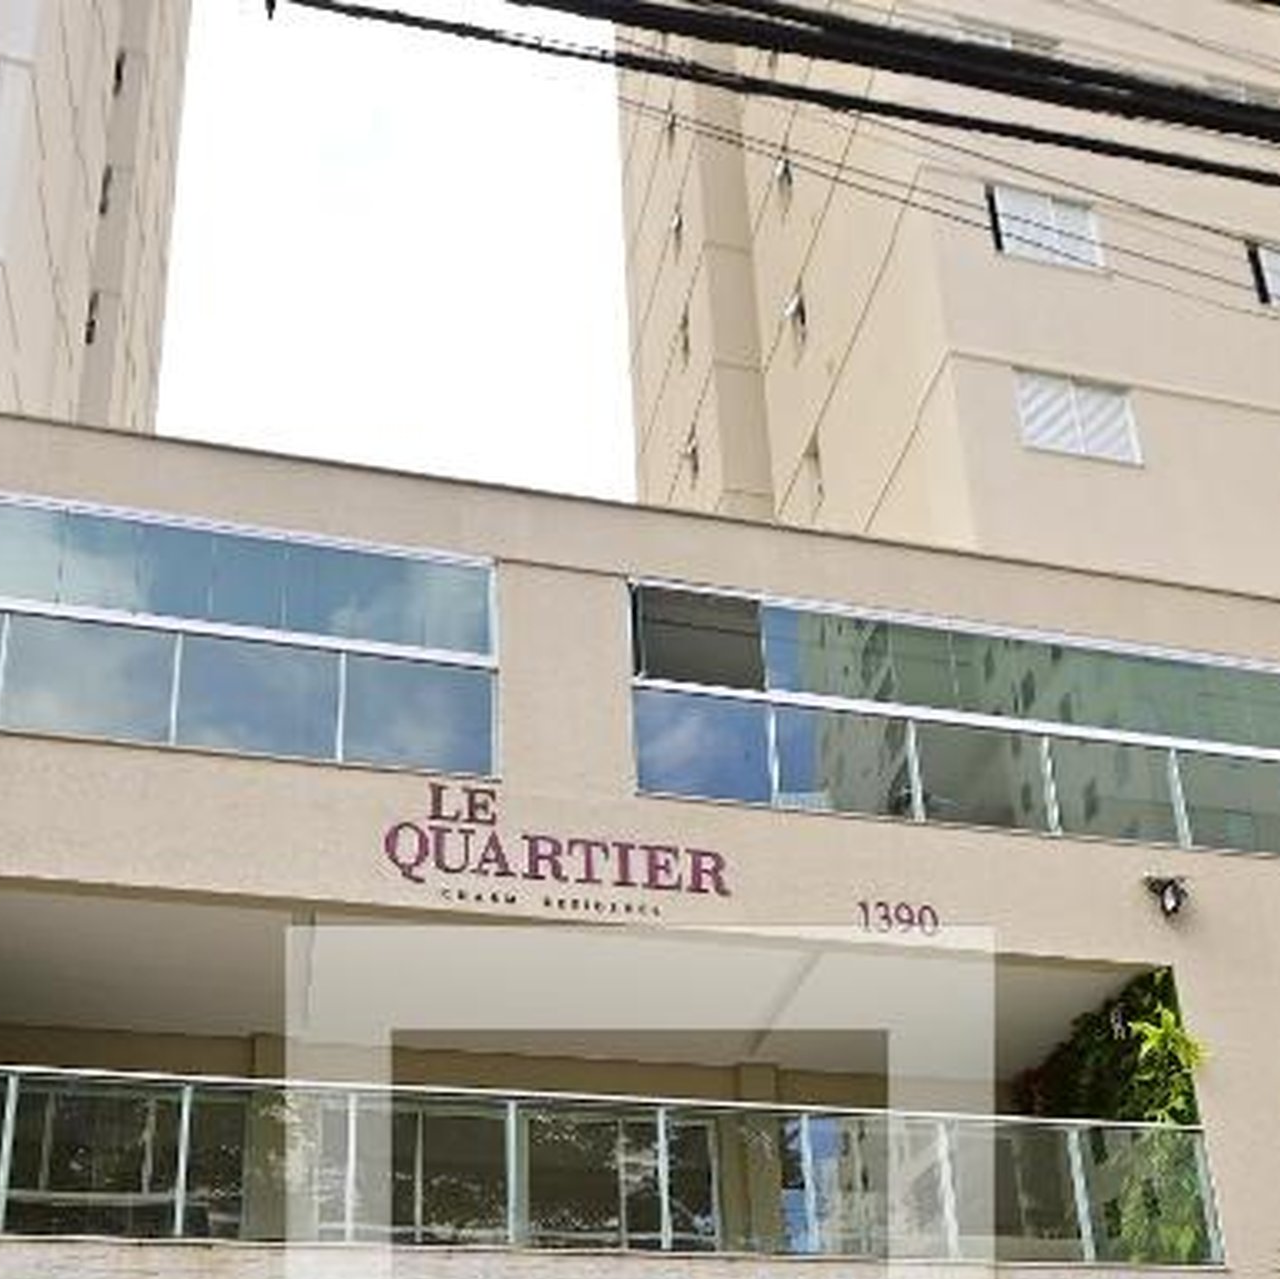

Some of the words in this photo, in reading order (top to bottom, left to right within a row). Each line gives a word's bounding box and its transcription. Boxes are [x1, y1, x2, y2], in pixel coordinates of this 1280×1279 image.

[427, 782, 498, 826] LE
[384, 822, 732, 897] QUARTIER
[857, 901, 939, 937] 1390
